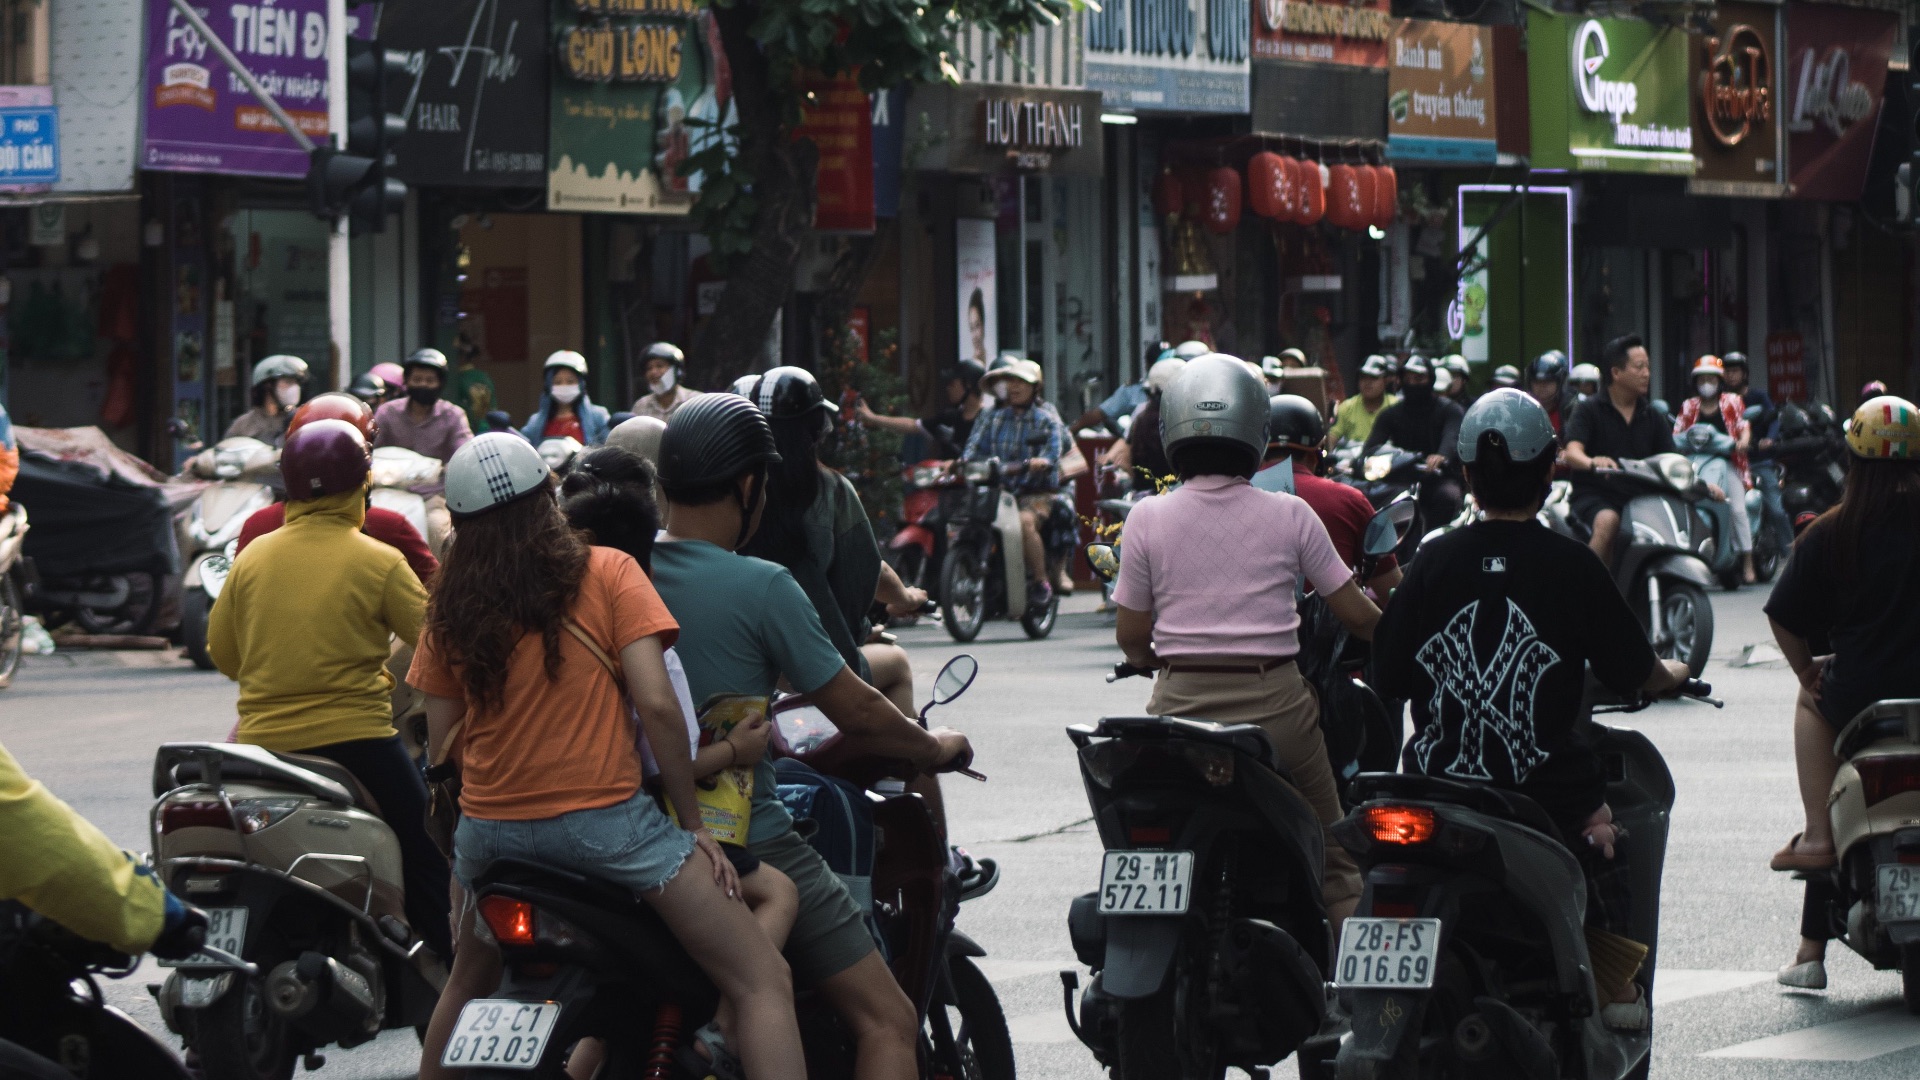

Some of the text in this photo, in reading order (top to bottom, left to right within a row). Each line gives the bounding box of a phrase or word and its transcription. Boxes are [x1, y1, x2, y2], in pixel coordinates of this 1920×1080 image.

[620, 27, 682, 78] LONG
[1575, 19, 1637, 124] Grape
[417, 102, 461, 131] HAIR
[985, 100, 1019, 146] HUY
[1114, 854, 1179, 881] 29-M1
[1104, 883, 1183, 910] 572.11
[1354, 922, 1425, 951] 28-FS
[1343, 954, 1429, 983] 016.69
[468, 1004, 543, 1033] 29-C1
[449, 1034, 540, 1064] 813.03
